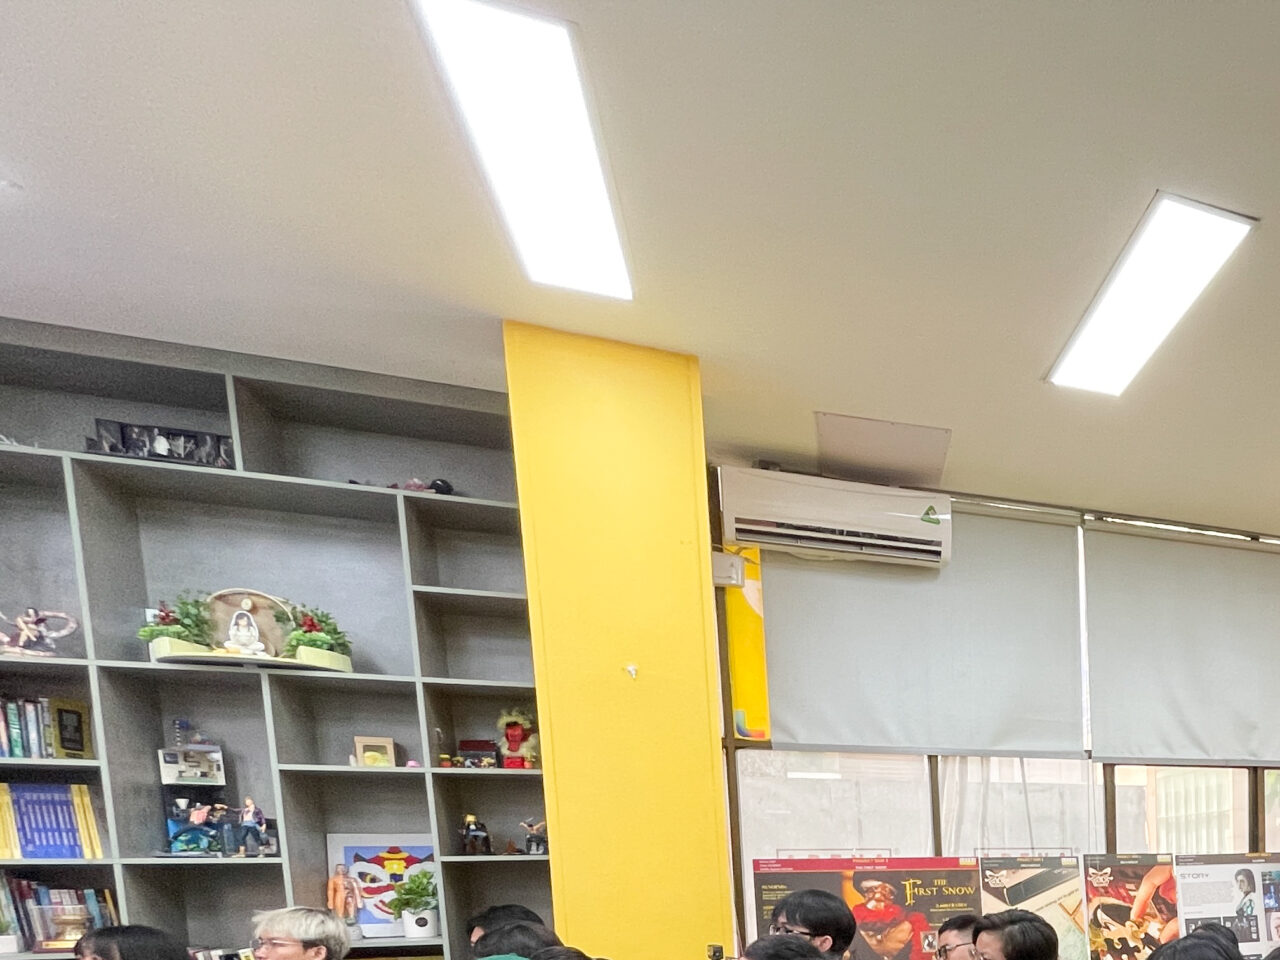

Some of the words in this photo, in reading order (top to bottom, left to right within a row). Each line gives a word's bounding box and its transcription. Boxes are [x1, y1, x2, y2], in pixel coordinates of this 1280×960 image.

[1179, 872, 1209, 880] STORY
[901, 879, 938, 905] FIRST
[942, 887, 975, 896] SNOW
